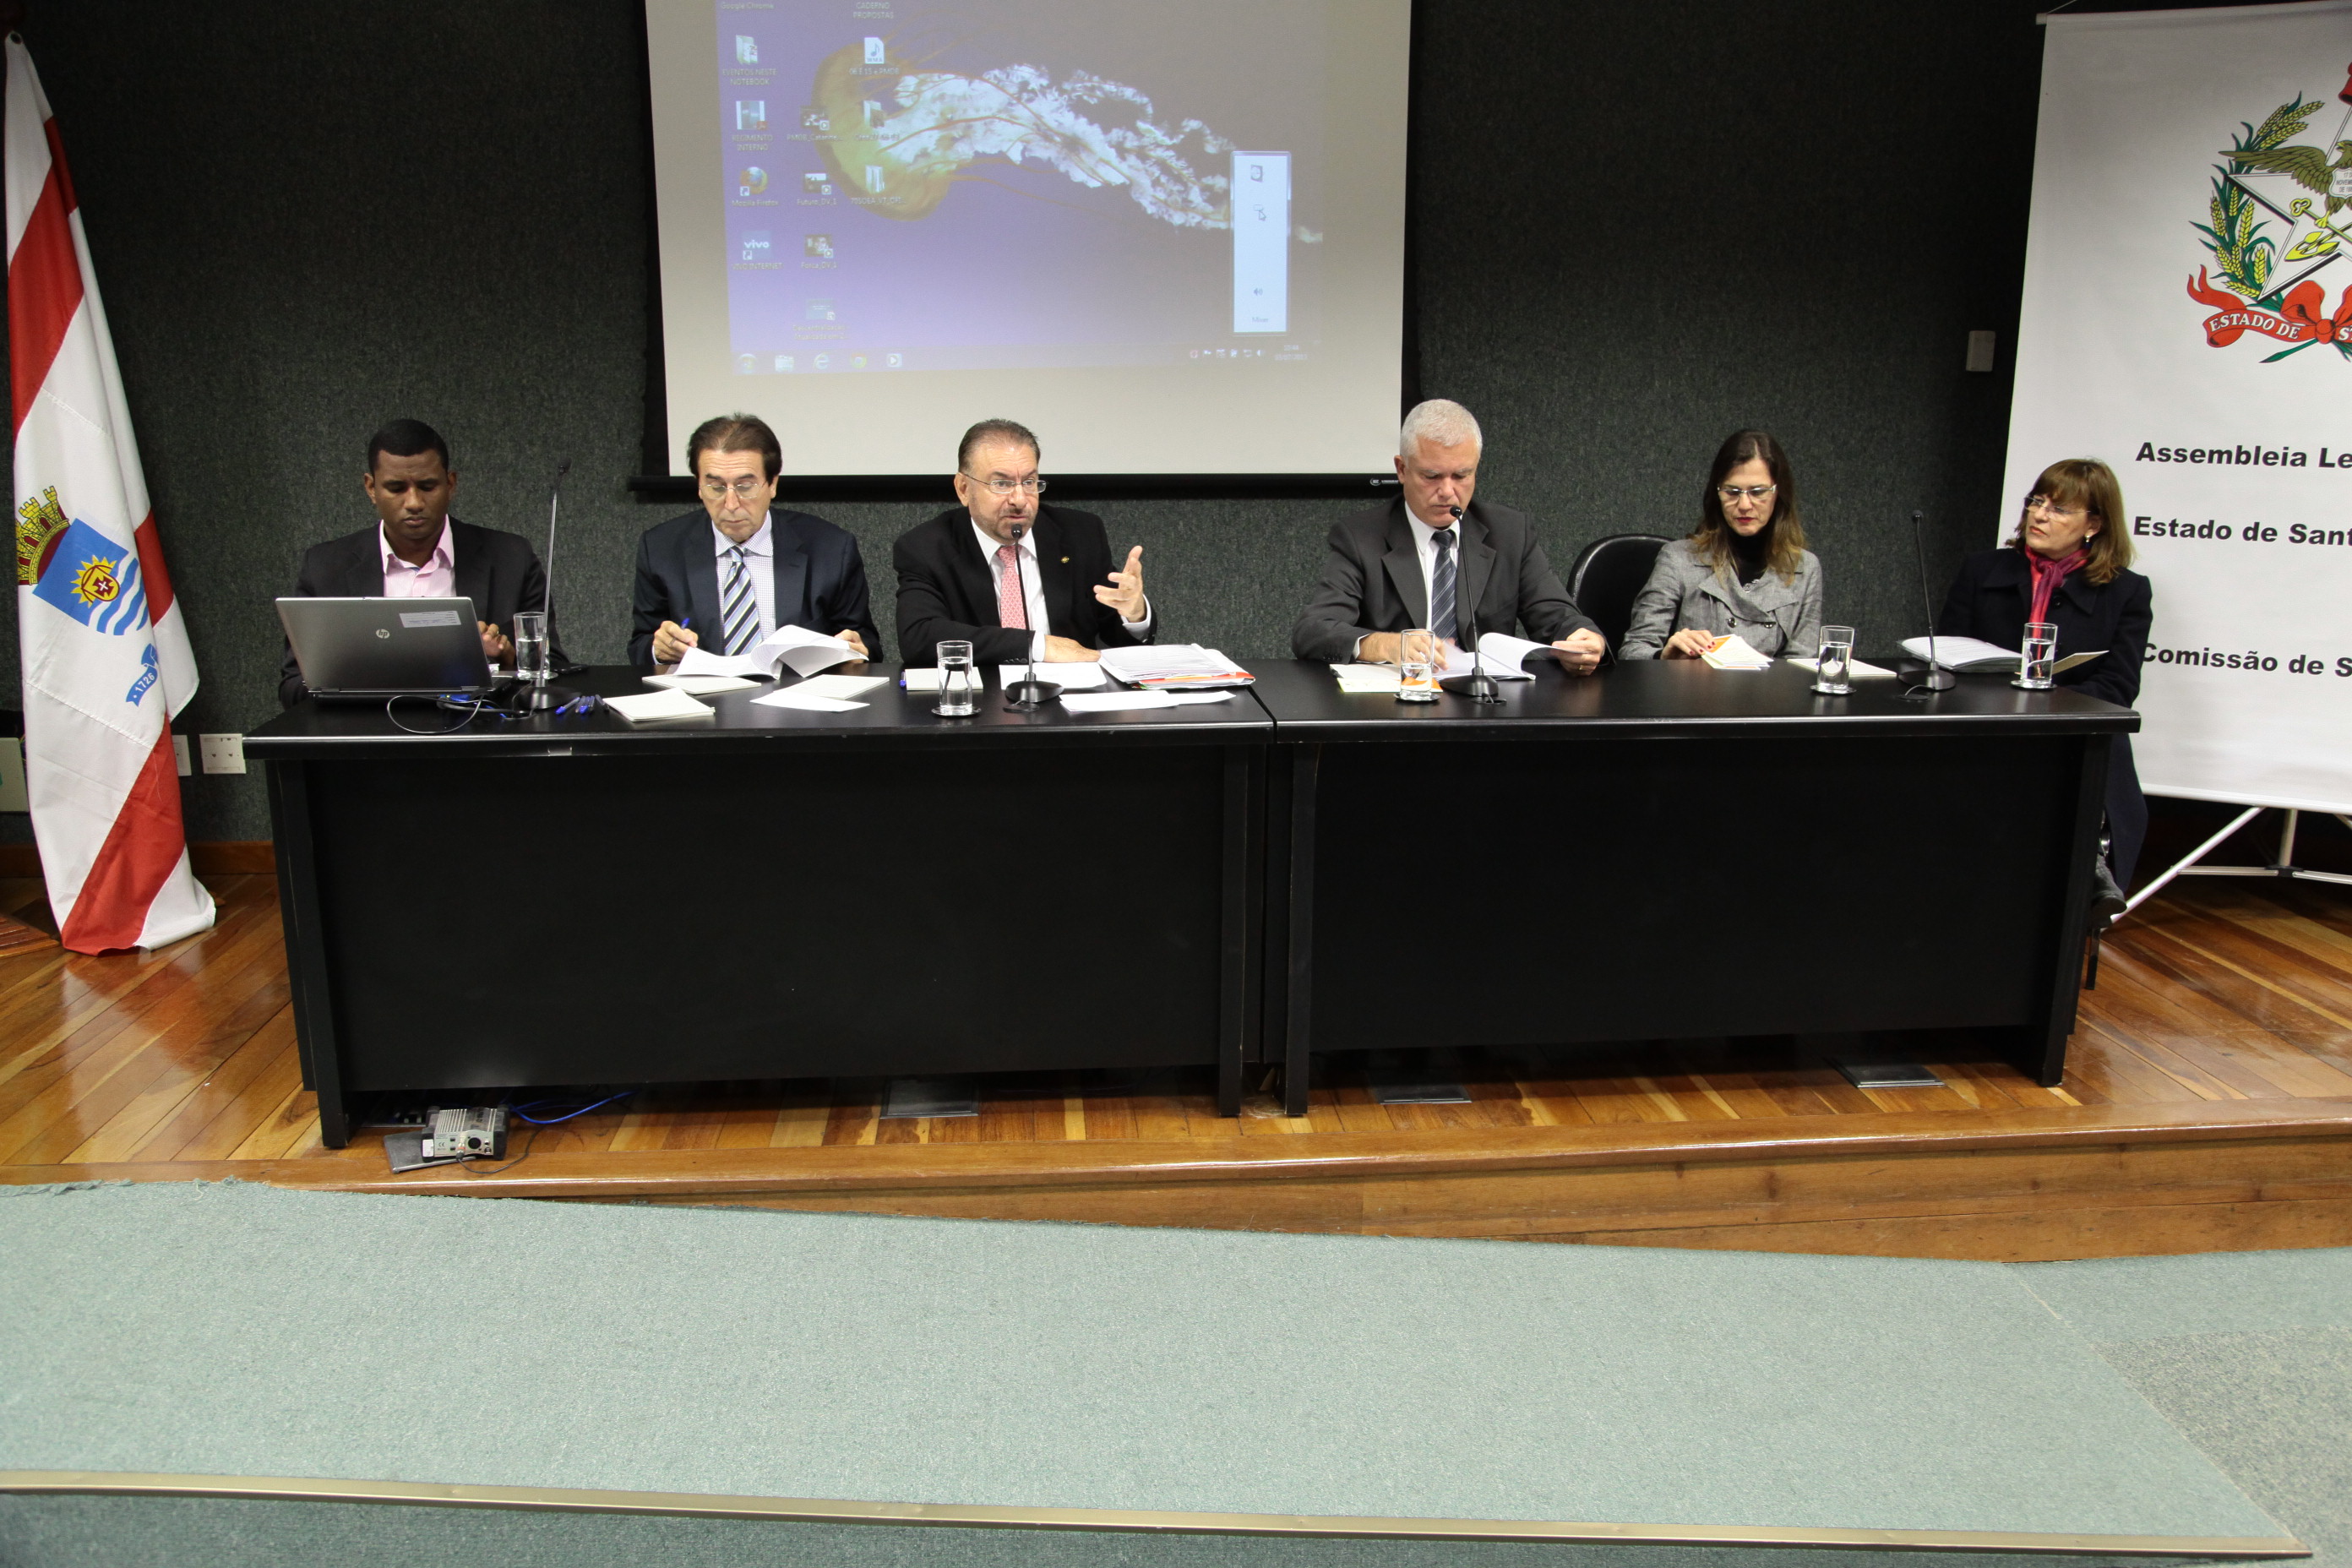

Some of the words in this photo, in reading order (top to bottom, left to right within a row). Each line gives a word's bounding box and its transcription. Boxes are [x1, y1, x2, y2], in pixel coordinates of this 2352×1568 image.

[852, 11, 895, 19] PROPOSTAS
[743, 240, 770, 249] vivo
[2209, 313, 2275, 332] ESTADO
[2276, 326, 2300, 340] DE
[2135, 442, 2308, 467] Assembleia
[2318, 447, 2352, 469] Le
[2133, 516, 2233, 541] Estado
[2242, 521, 2278, 542] de
[2142, 643, 2278, 672] Comissão
[2288, 654, 2325, 676] de
[2335, 656, 2352, 678] S
[135, 672, 155, 692] 1726
